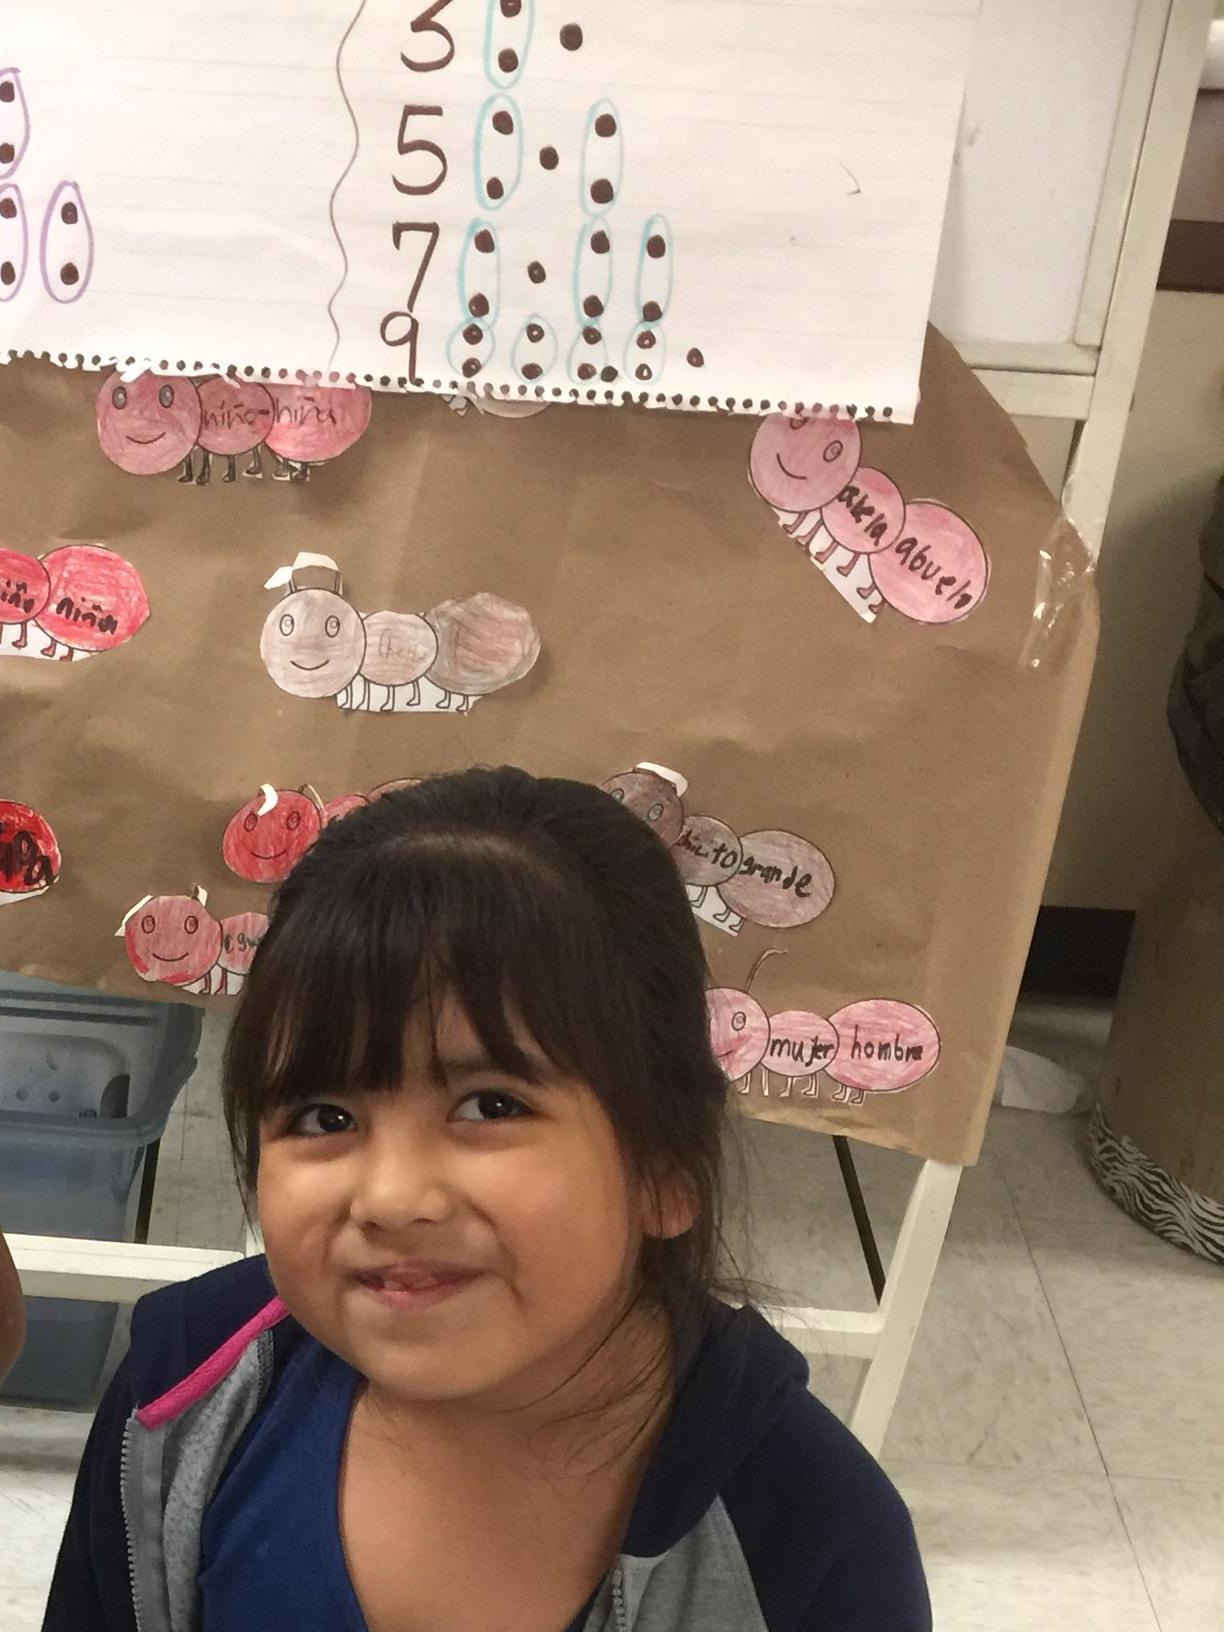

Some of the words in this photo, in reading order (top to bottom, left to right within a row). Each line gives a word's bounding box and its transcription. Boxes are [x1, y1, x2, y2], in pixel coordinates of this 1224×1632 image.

[391, 104, 448, 196] 5
[391, 222, 440, 312] 7
[379, 311, 420, 383] 9
